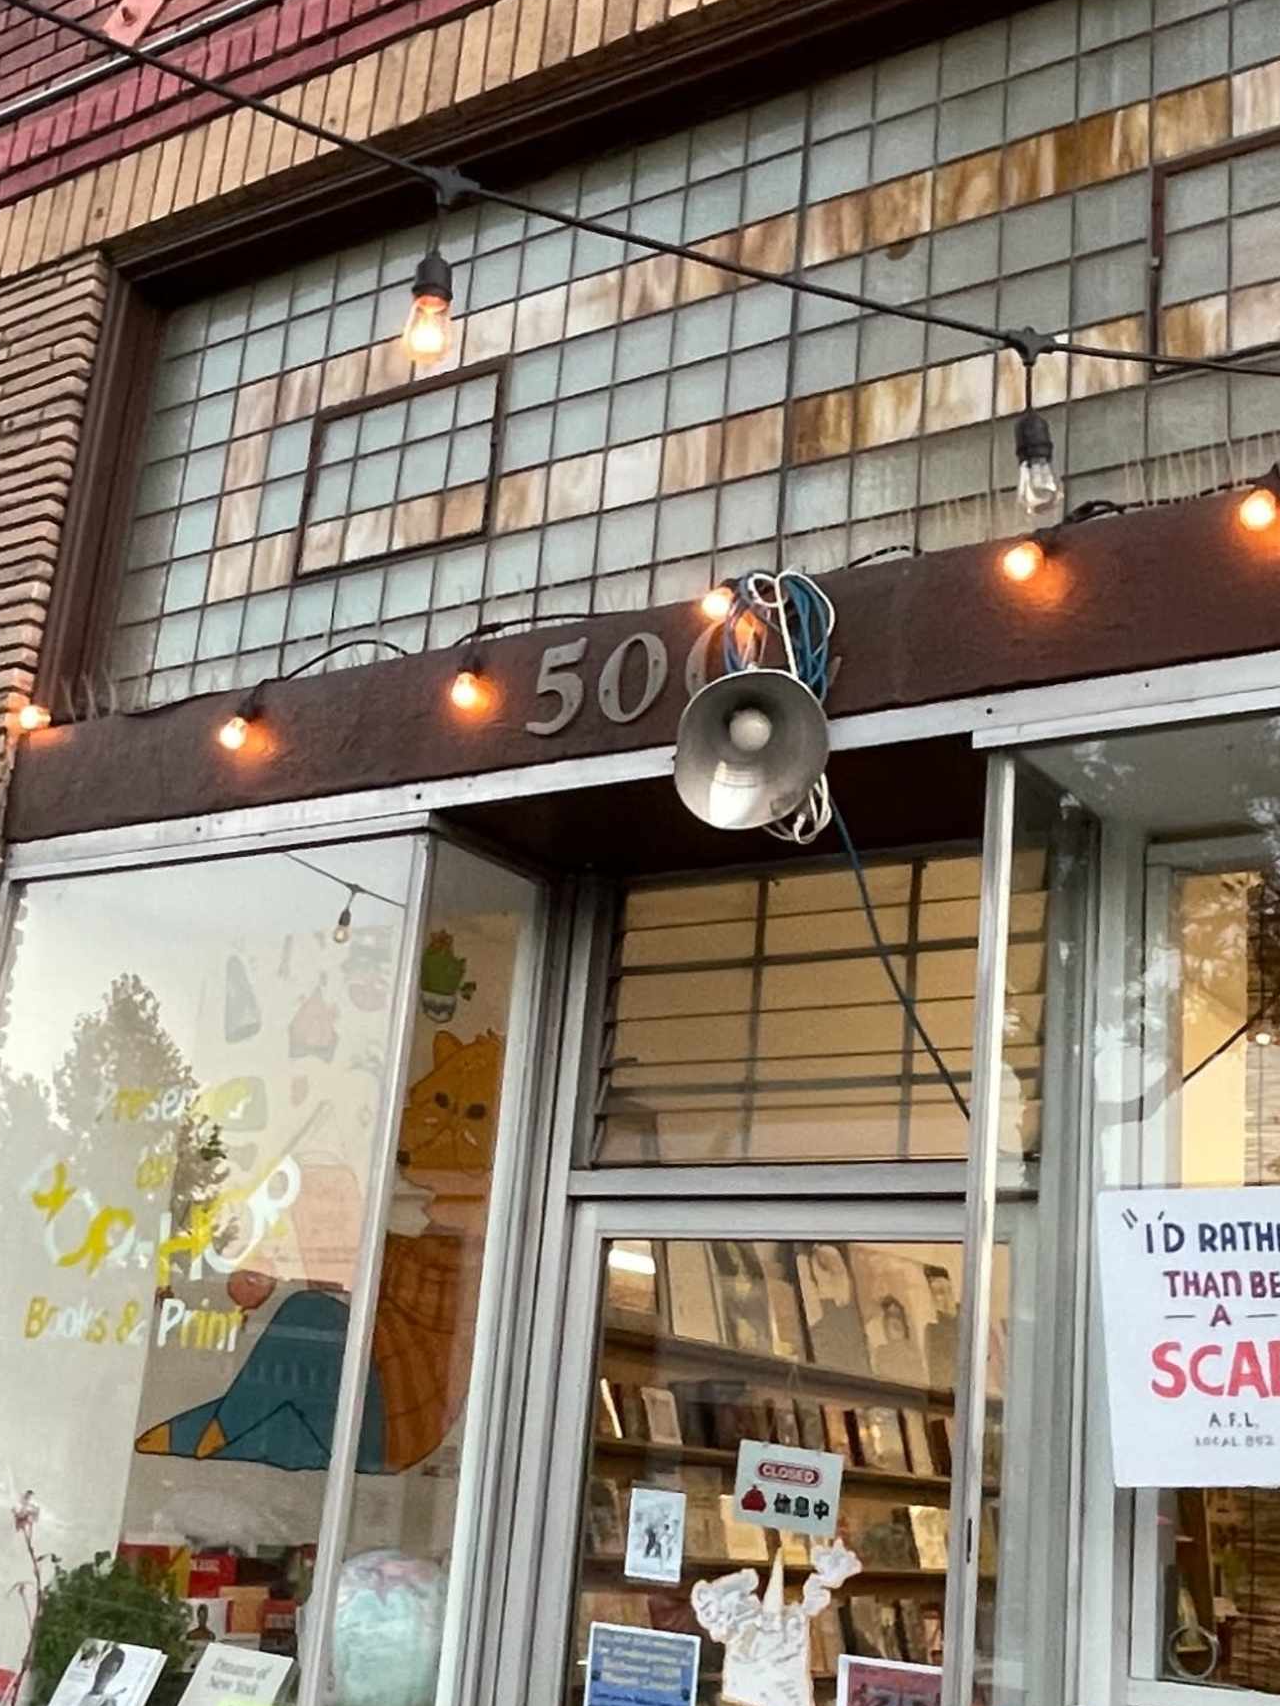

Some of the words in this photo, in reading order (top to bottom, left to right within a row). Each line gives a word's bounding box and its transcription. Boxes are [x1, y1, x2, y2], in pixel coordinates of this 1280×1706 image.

[1163, 1270, 1243, 1299] THAN
[24, 1296, 108, 1344] Books
[157, 1296, 245, 1352] Print
[1209, 1304, 1232, 1328] A
[1194, 1435, 1239, 1448] LOCAL
[762, 1463, 815, 1484] CLOSED
